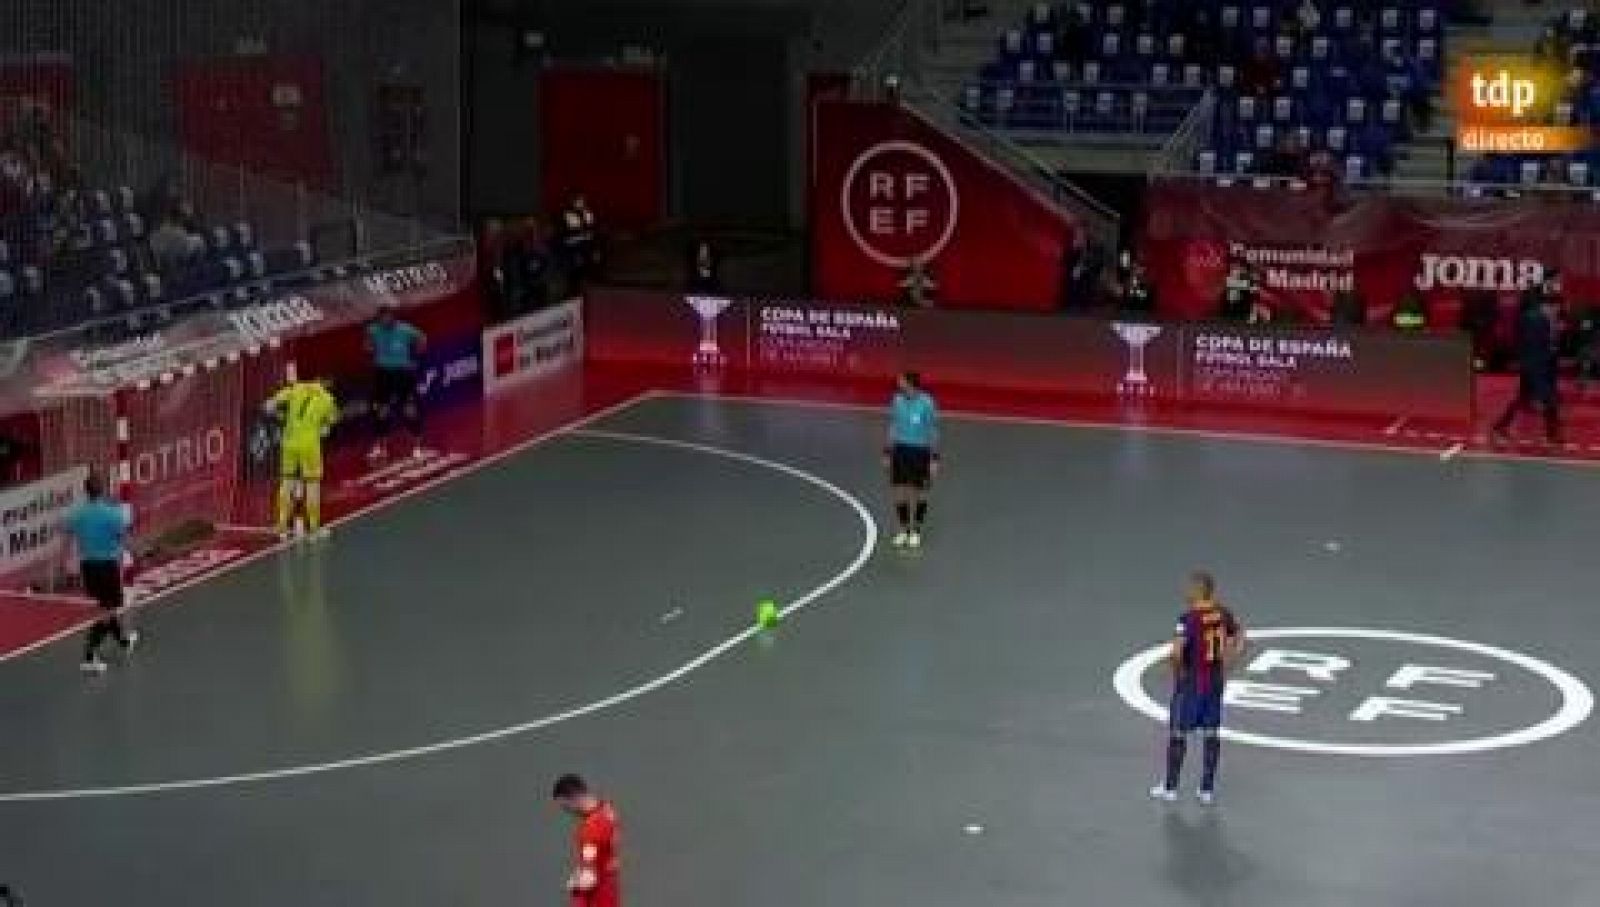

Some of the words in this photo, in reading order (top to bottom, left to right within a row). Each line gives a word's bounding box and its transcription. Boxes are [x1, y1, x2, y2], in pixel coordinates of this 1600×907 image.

[1266, 267, 1354, 292] Madrid
[760, 306, 804, 322] COPA
[809, 309, 831, 323] DE
[833, 311, 899, 328] ESPAÑA
[816, 325, 850, 338] SALA
[1196, 334, 1244, 351] COPA
[1249, 338, 1274, 352] DE
[1278, 338, 1351, 358] ESPAÑA
[1258, 355, 1297, 369] SALA
[136, 429, 224, 482] OTRIO
